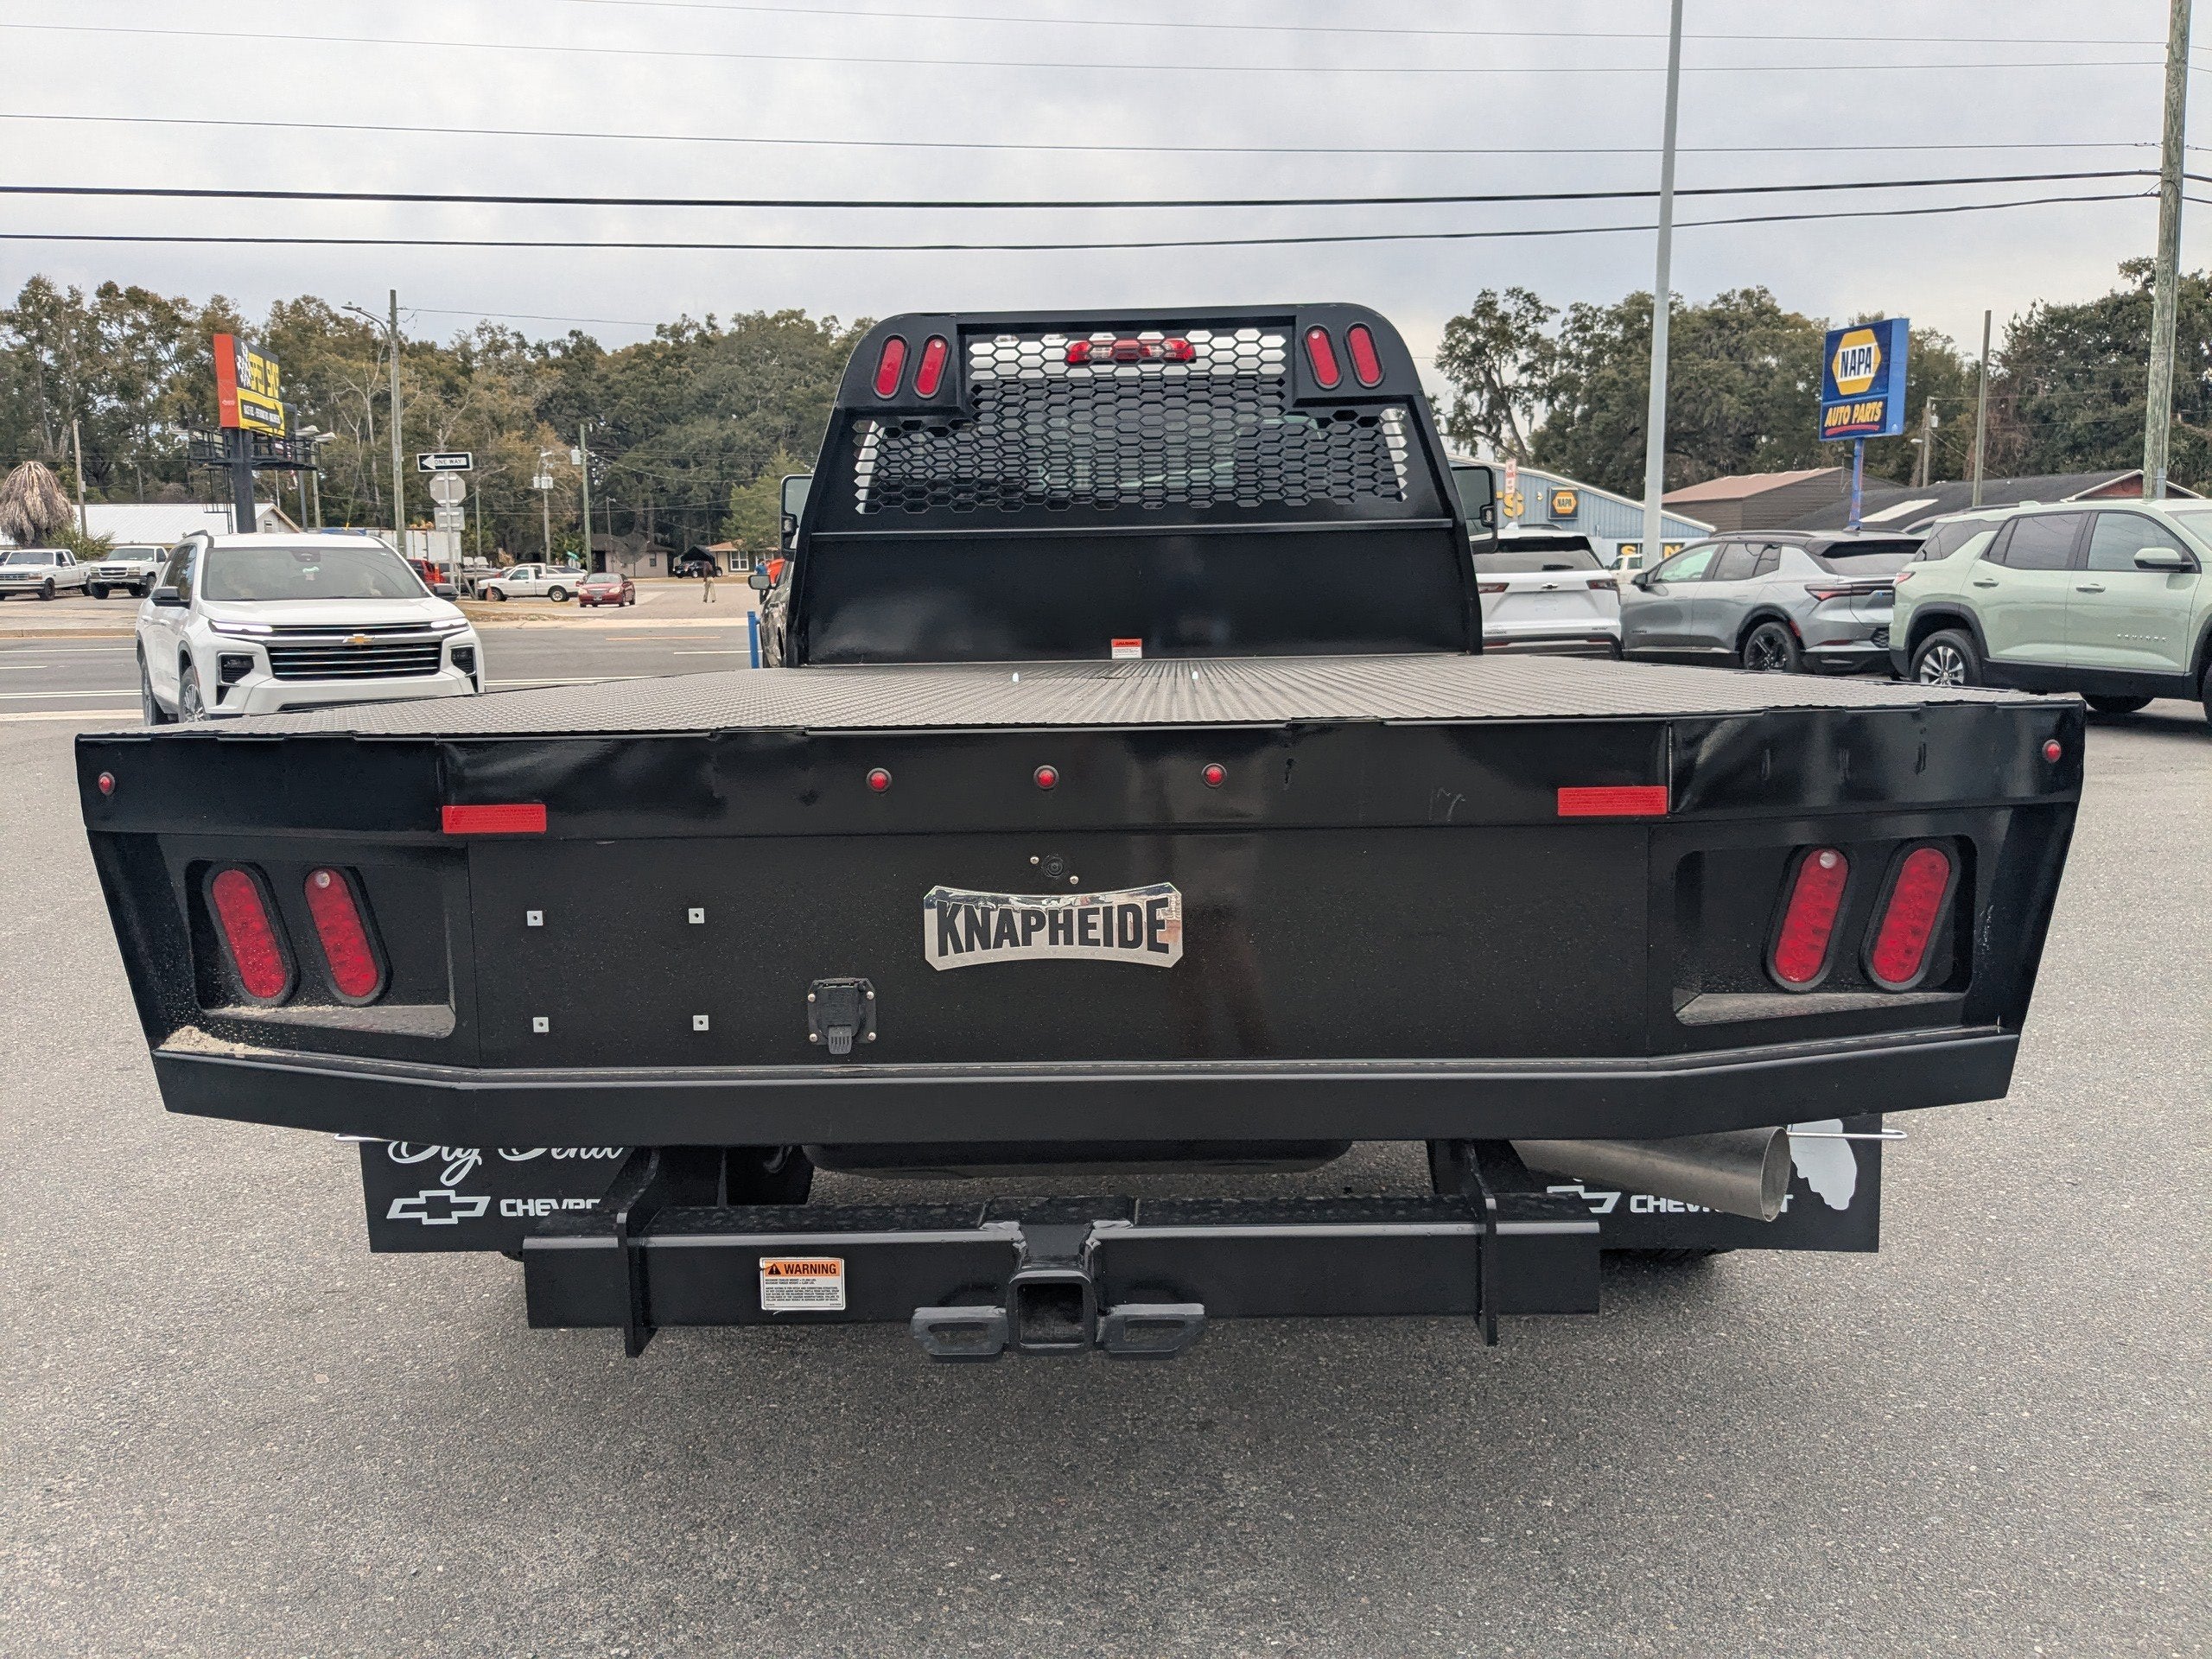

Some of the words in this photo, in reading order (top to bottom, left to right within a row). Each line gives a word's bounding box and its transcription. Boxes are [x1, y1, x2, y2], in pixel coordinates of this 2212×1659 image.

[1840, 346, 1872, 378] NAPA
[1823, 404, 1851, 428] AUTO
[1851, 401, 1884, 424] PARTS
[1556, 498, 1573, 507] NAPA
[936, 896, 1170, 958] KNAPHEIDE
[784, 1263, 837, 1274] WARNING
